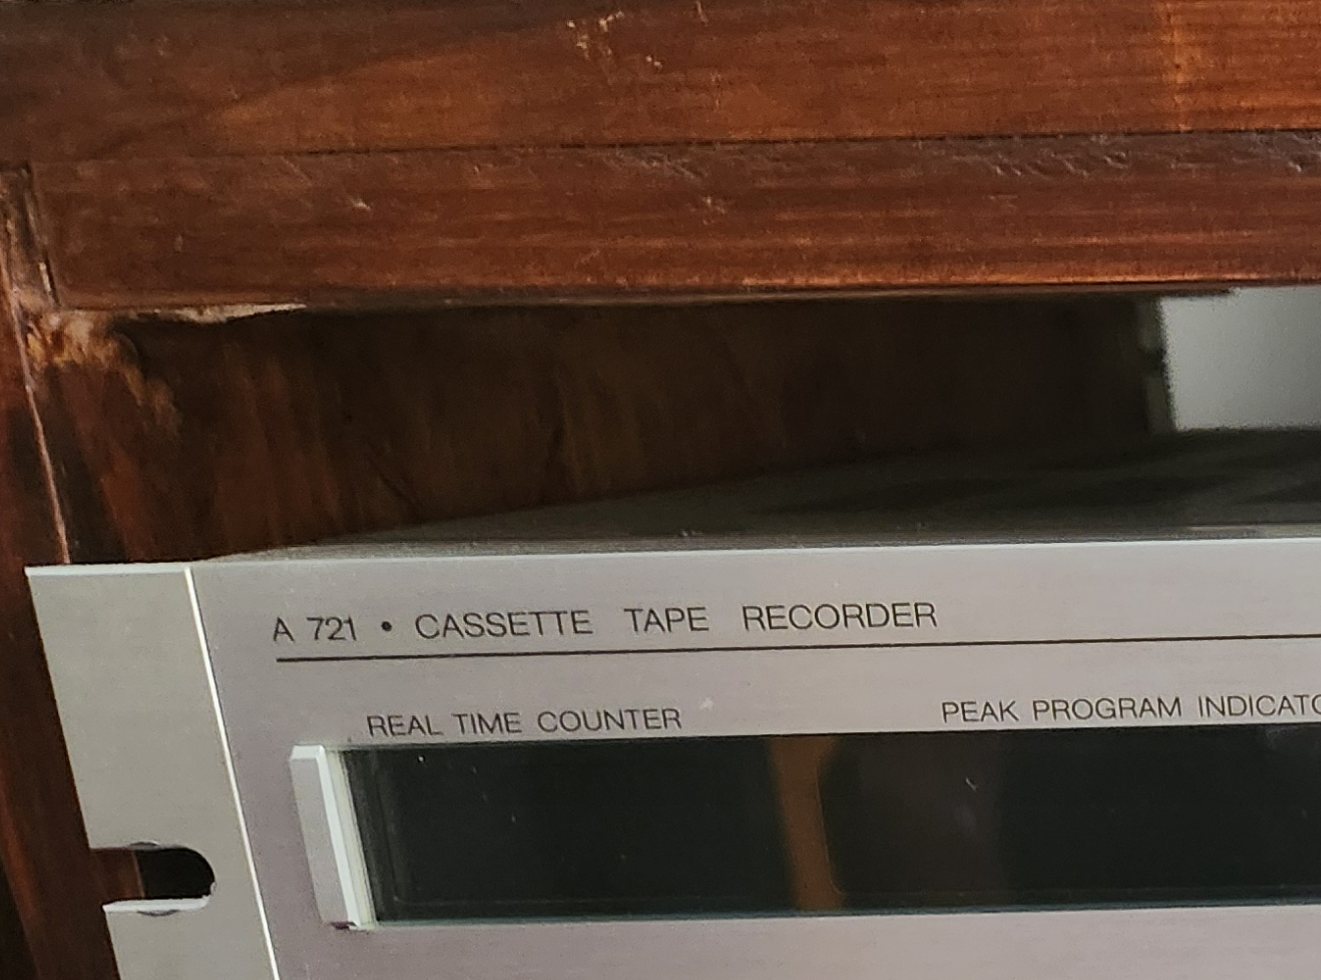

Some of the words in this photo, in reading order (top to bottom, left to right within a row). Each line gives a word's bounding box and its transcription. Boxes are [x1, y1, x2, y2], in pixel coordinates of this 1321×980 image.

[272, 616, 295, 642] A
[306, 616, 357, 642] 721
[414, 609, 594, 640] CASSETTE
[623, 606, 710, 633] TAPE
[742, 602, 937, 631] RECORDER
[366, 715, 443, 737] REAL
[452, 712, 523, 735] TIME
[537, 708, 682, 733] COUNTER
[941, 700, 1019, 723] PEAK
[1032, 696, 1182, 721] PROGRAM
